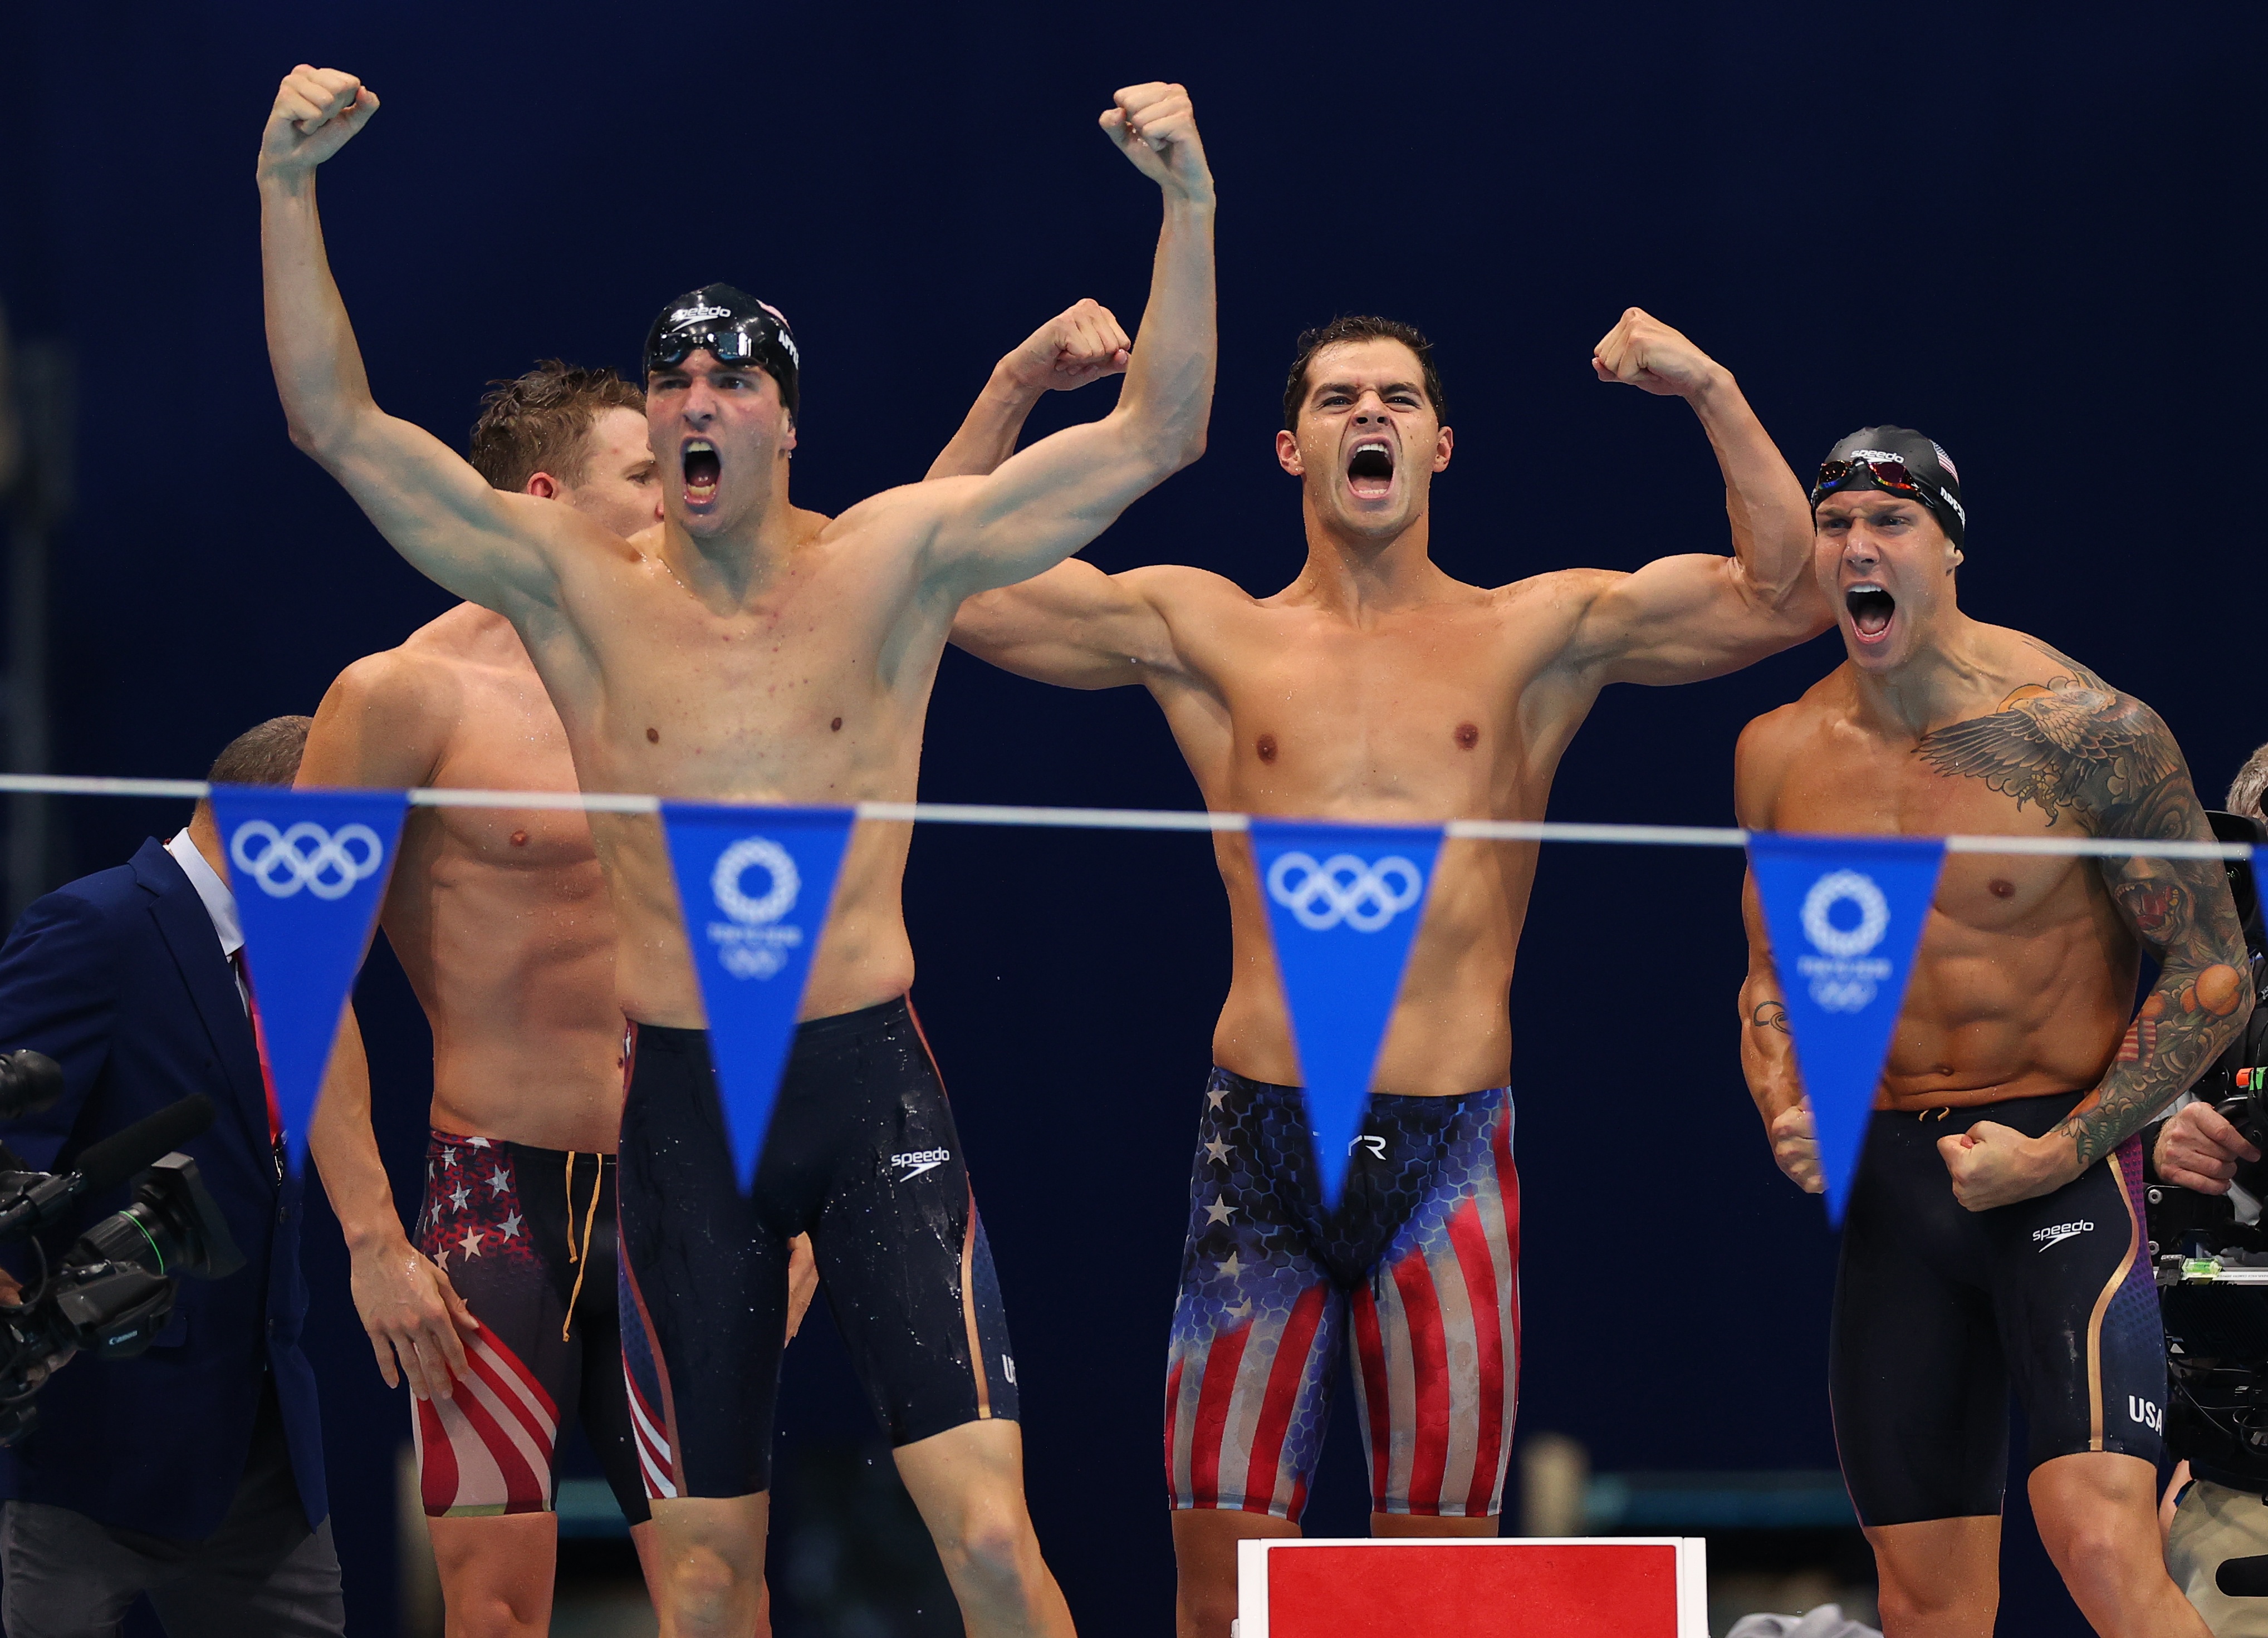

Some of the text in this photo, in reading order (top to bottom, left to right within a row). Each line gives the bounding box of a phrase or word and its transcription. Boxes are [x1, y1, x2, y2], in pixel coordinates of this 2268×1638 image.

[669, 306, 731, 322] speedo
[1850, 449, 1904, 464] speedo
[891, 1146, 950, 1168] speedo
[2032, 1219, 2094, 1241] speedo
[2128, 1395, 2163, 1436] USA
